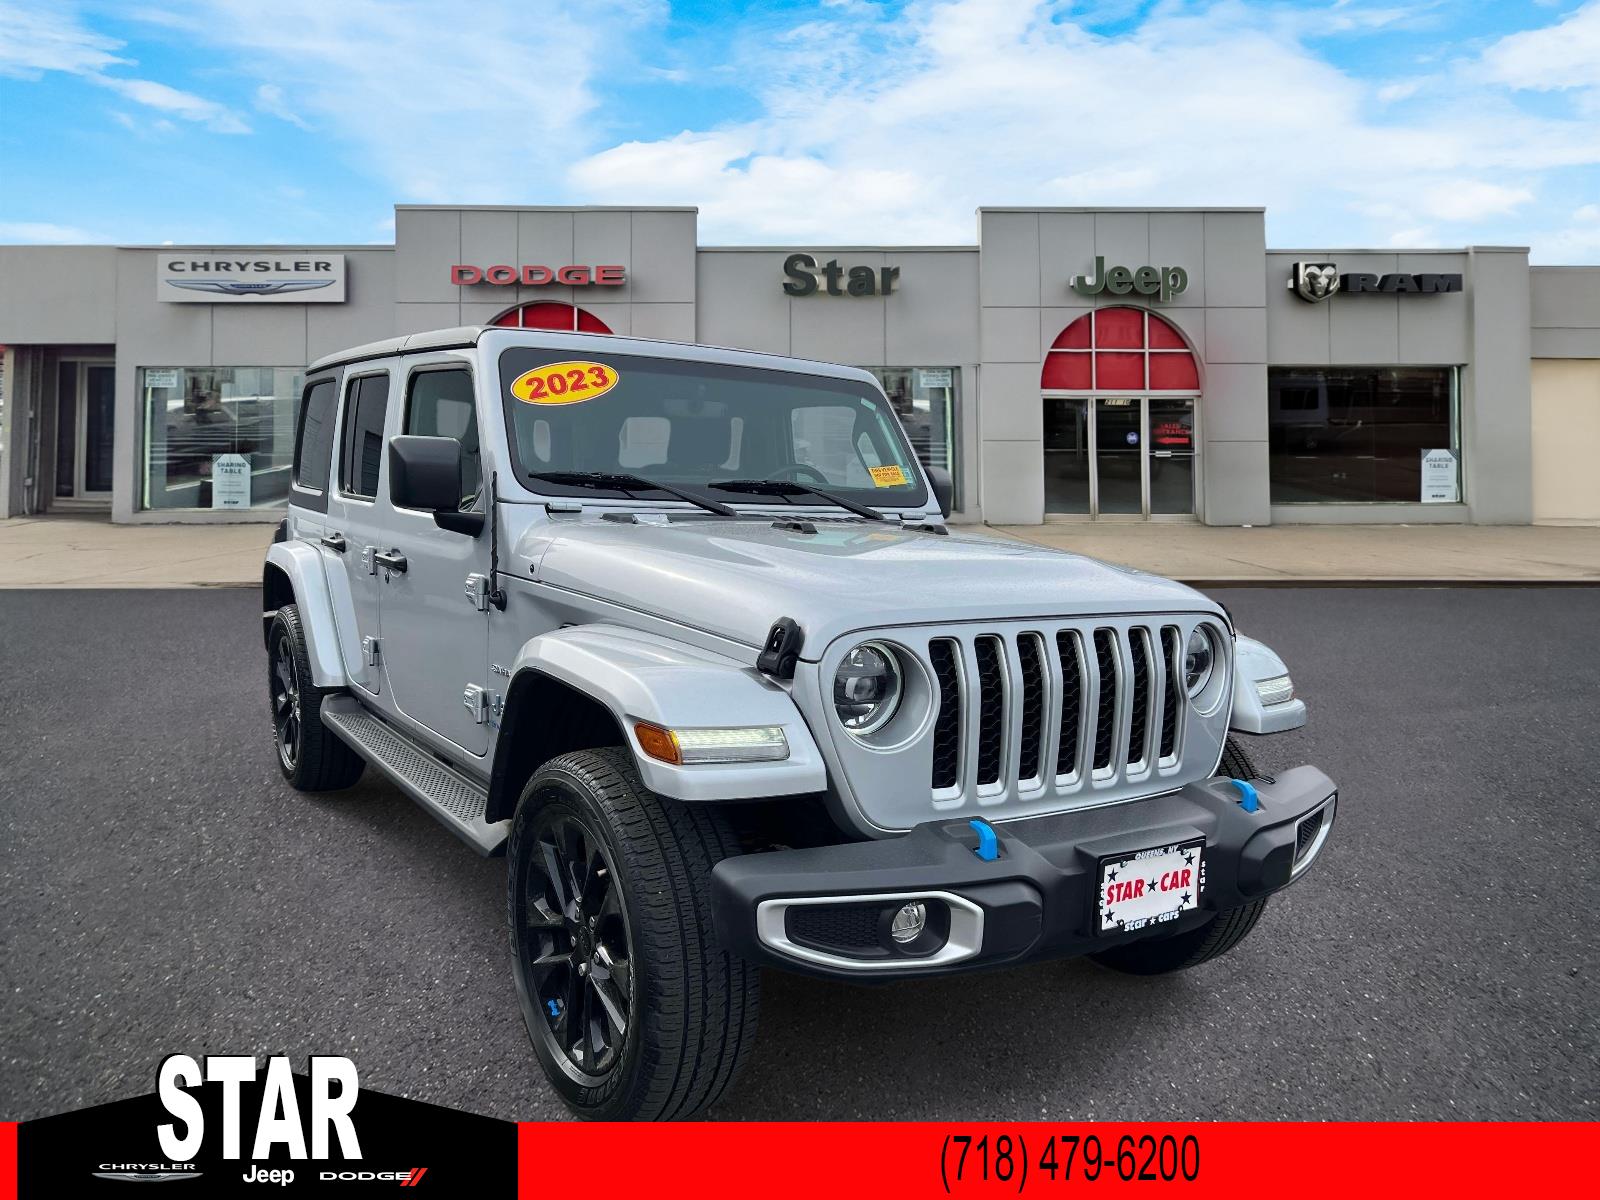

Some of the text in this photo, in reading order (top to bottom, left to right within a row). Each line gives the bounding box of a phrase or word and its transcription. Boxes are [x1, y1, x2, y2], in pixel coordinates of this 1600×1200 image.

[167, 261, 332, 273] CHRYSLER
[450, 265, 626, 286] DODGE
[782, 253, 900, 297] Star
[1069, 255, 1188, 302] Jeep
[1340, 273, 1463, 292] RAM
[525, 365, 610, 400] 2023
[1168, 845, 1179, 854] NY
[1106, 869, 1191, 905] STAR CAR
[1124, 910, 1180, 932] star cars
